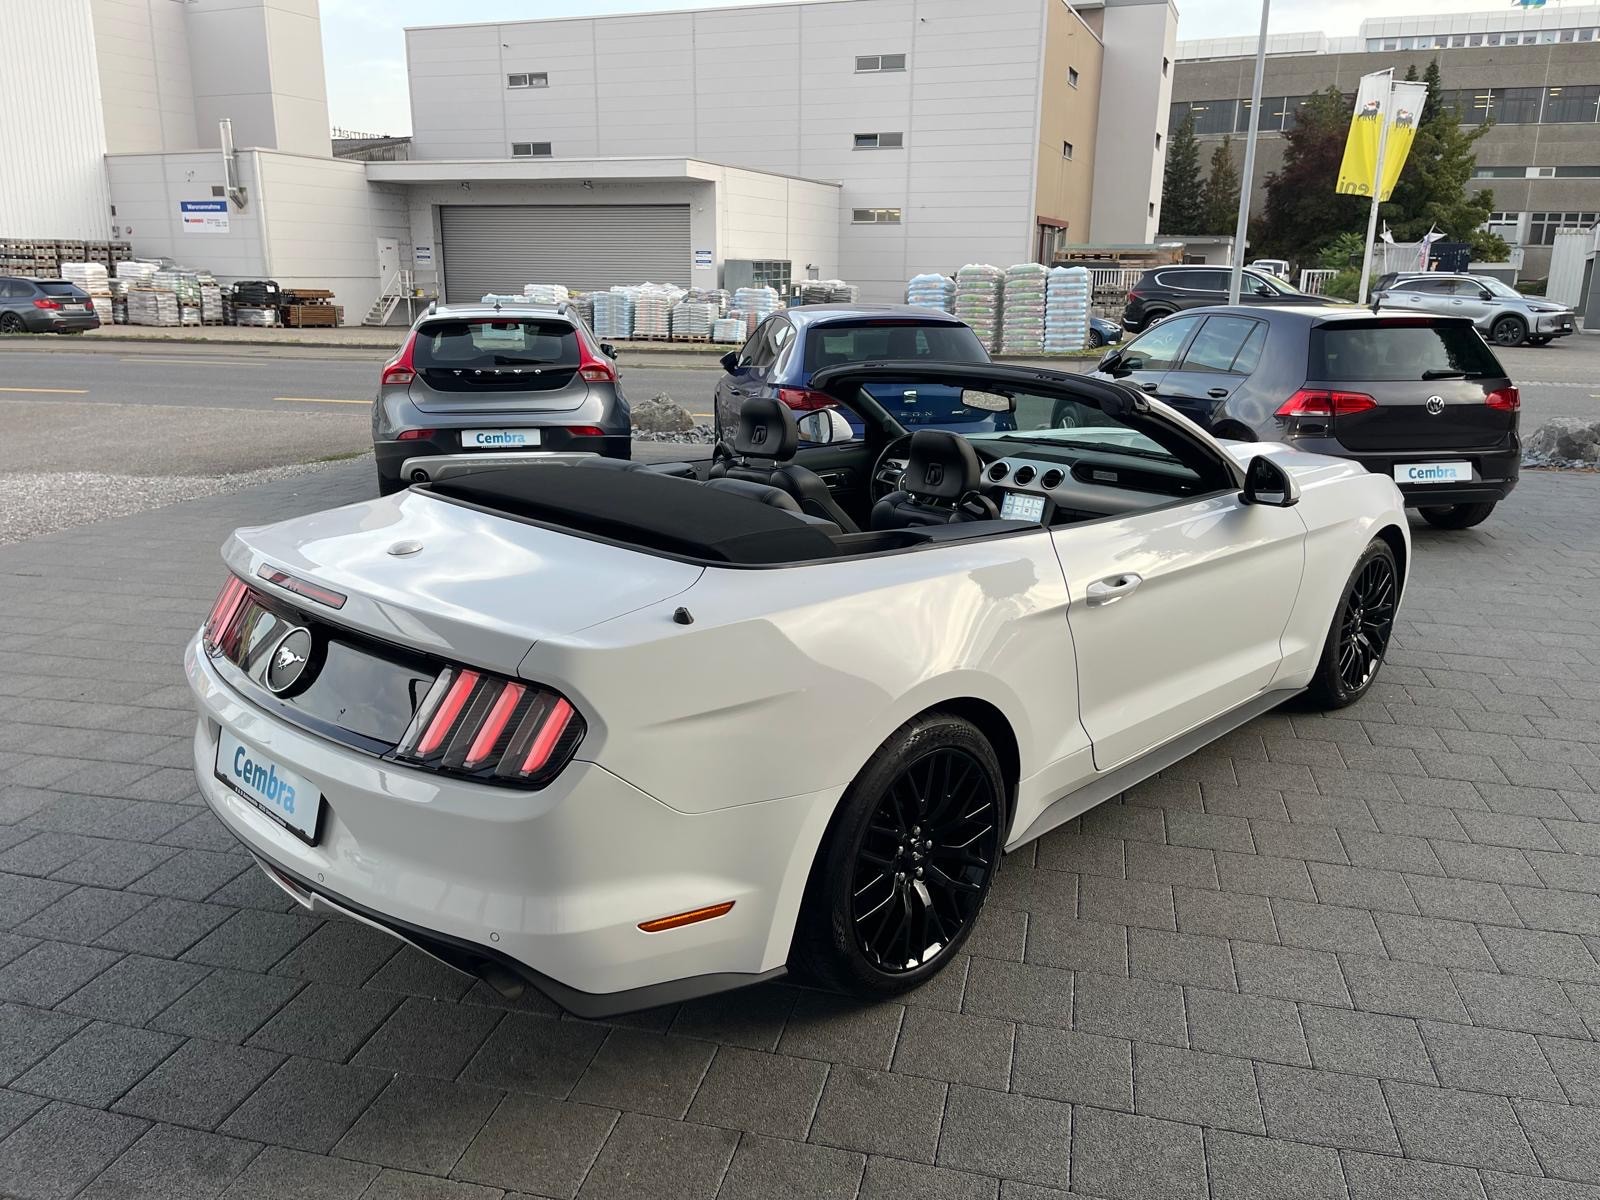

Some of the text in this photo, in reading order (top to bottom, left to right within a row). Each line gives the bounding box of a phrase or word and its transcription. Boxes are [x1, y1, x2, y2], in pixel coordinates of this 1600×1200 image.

[476, 432, 526, 444] Cembra
[1408, 466, 1457, 479] Cembra
[234, 746, 296, 814] Cembra
